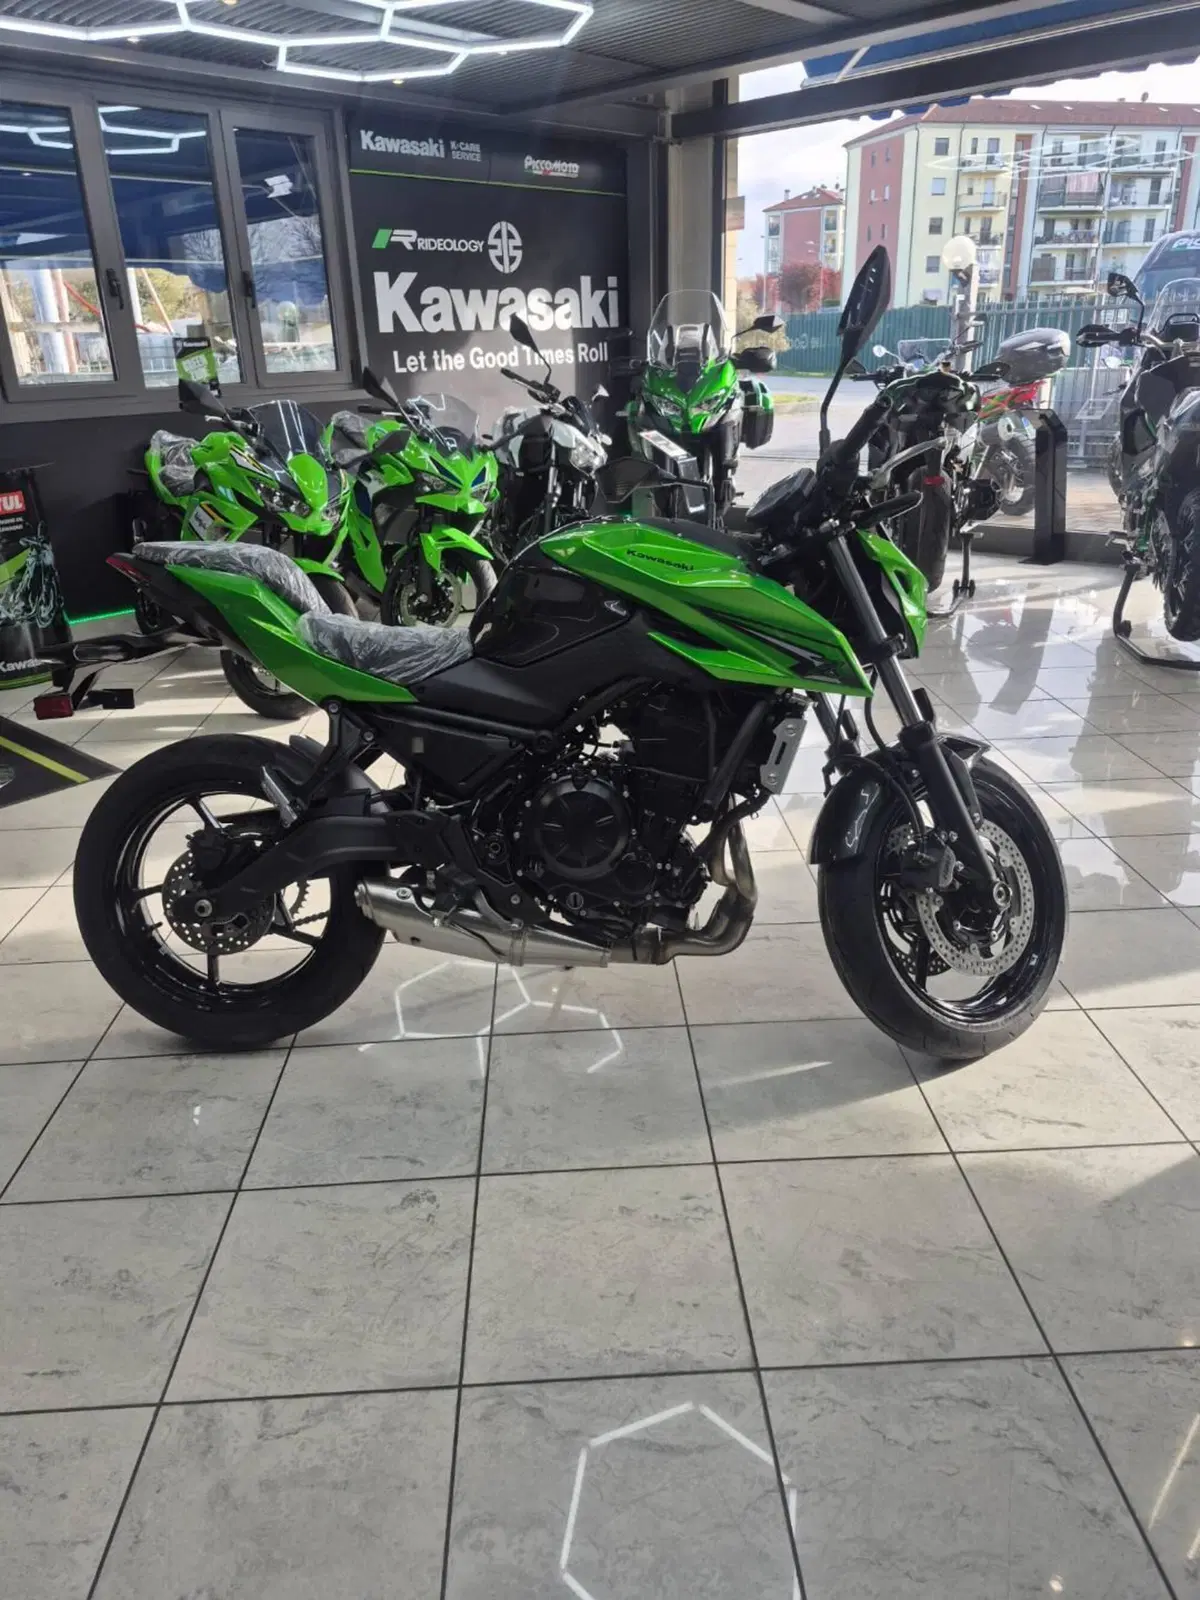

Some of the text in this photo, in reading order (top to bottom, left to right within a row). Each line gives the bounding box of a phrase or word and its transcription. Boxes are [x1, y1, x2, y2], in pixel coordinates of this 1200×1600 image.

[360, 129, 445, 159] Kawasaki
[452, 151, 481, 163] SERVICE
[417, 237, 485, 253] RIDEOLOGY
[373, 271, 620, 334] Kawasaki
[393, 348, 426, 374] Let
[432, 347, 465, 371] the
[469, 344, 519, 369] Good
[577, 341, 609, 363] Roll
[626, 548, 695, 572] Kawasaki
